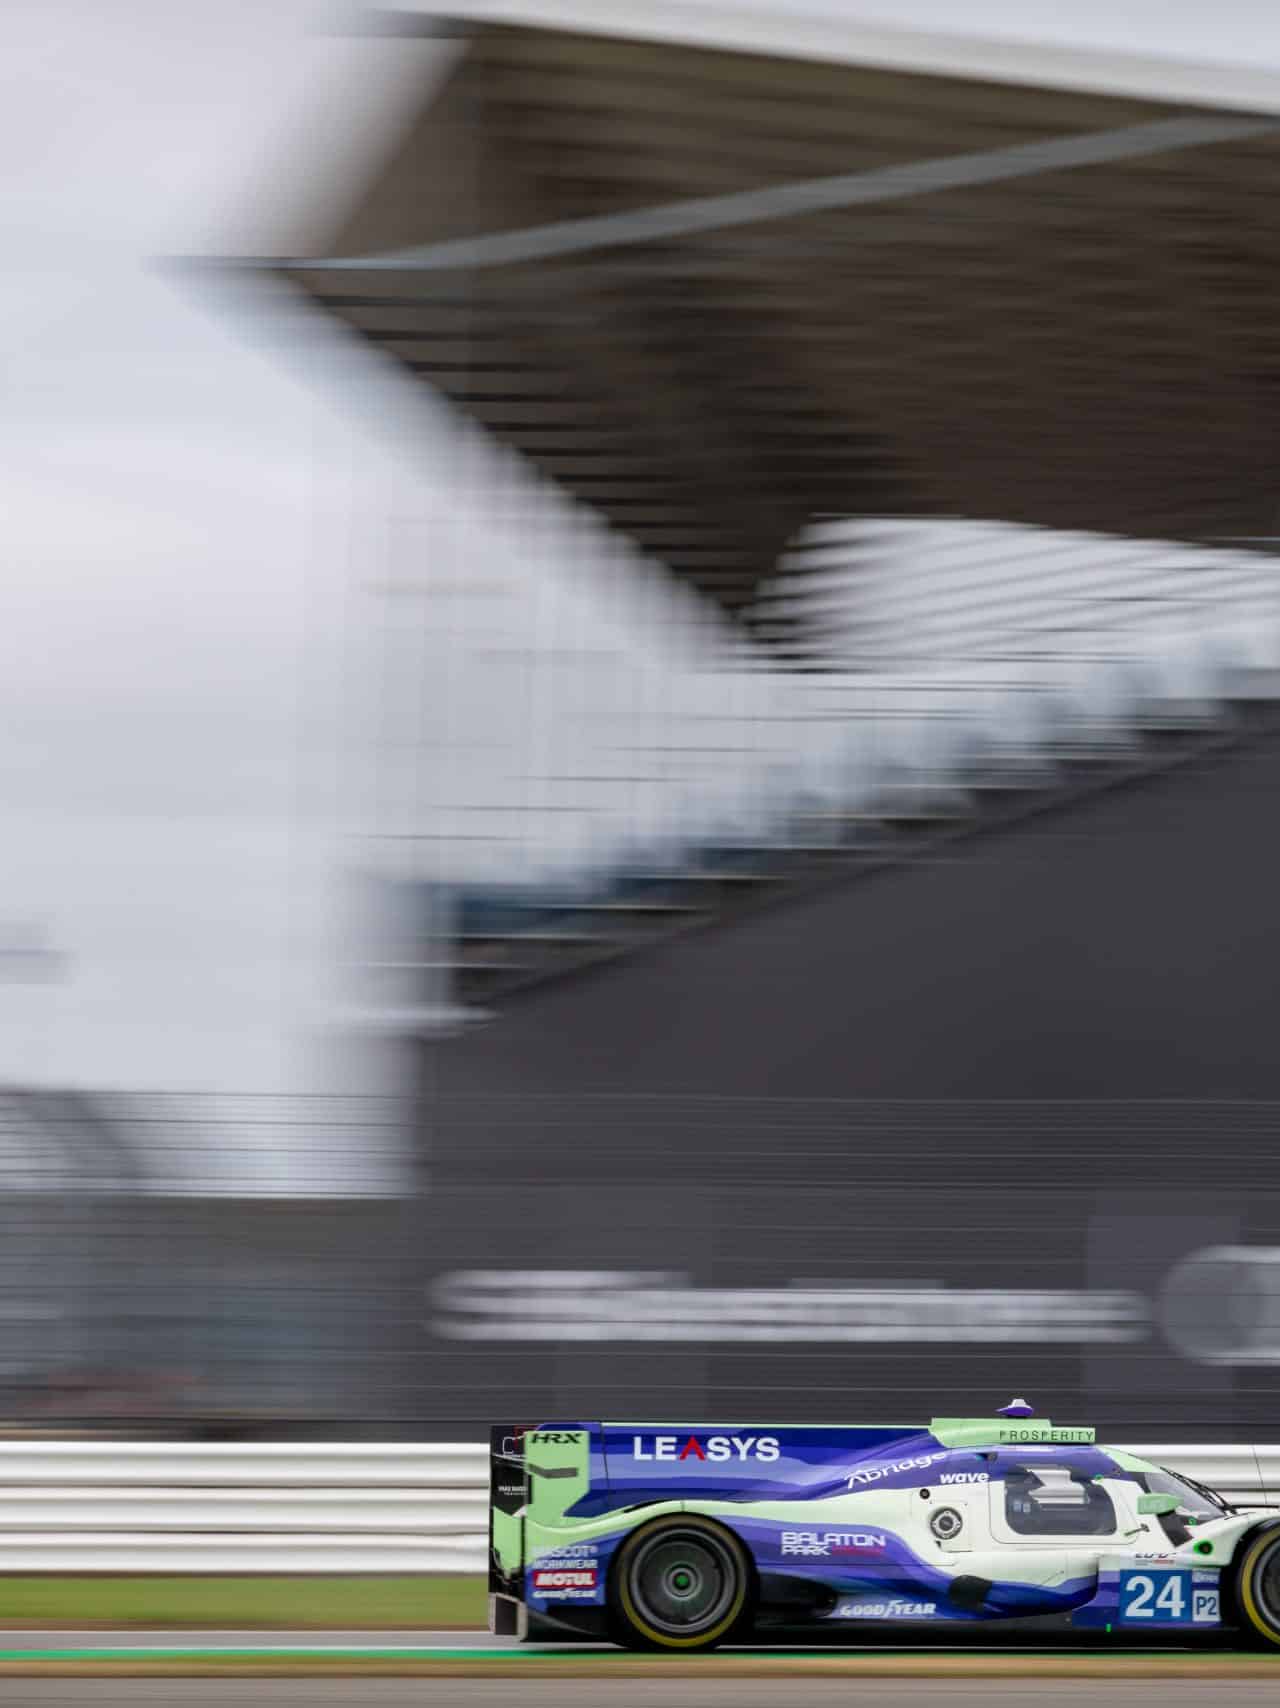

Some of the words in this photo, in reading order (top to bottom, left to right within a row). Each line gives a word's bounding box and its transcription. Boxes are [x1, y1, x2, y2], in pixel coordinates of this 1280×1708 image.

[531, 1433, 582, 1444] HRX
[1000, 1430, 1094, 1441] PROSPERITY
[633, 1435, 780, 1462] LEASYS
[940, 1472, 989, 1484] wave
[781, 1531, 886, 1547] BALATON
[781, 1545, 832, 1556] PARK
[536, 1572, 594, 1586] MOTUL
[1125, 1575, 1186, 1617] 24
[1196, 1596, 1217, 1616] P2
